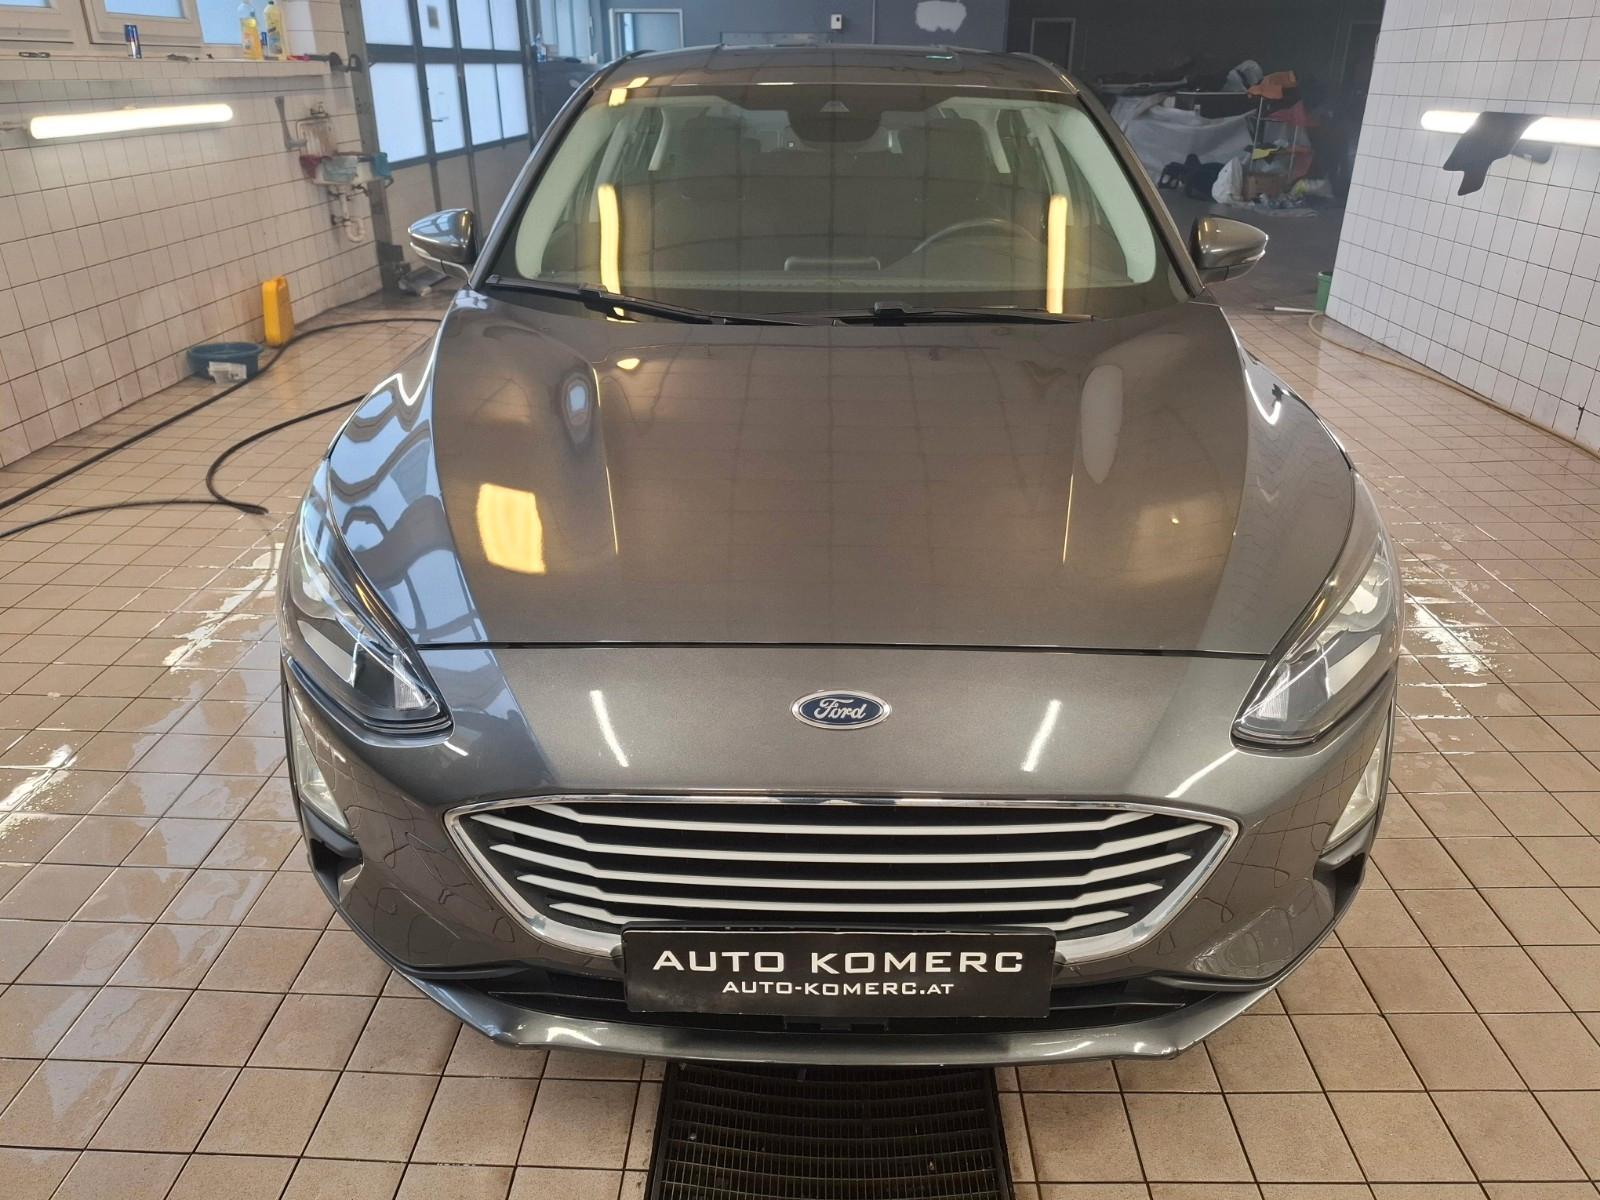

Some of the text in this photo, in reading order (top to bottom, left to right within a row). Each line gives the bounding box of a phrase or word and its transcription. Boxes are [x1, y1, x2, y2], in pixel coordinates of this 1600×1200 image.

[813, 698, 867, 719] Ford
[652, 950, 1024, 974] AUTO KOMERC
[722, 981, 955, 995] AUTO-KOMERC.AT
